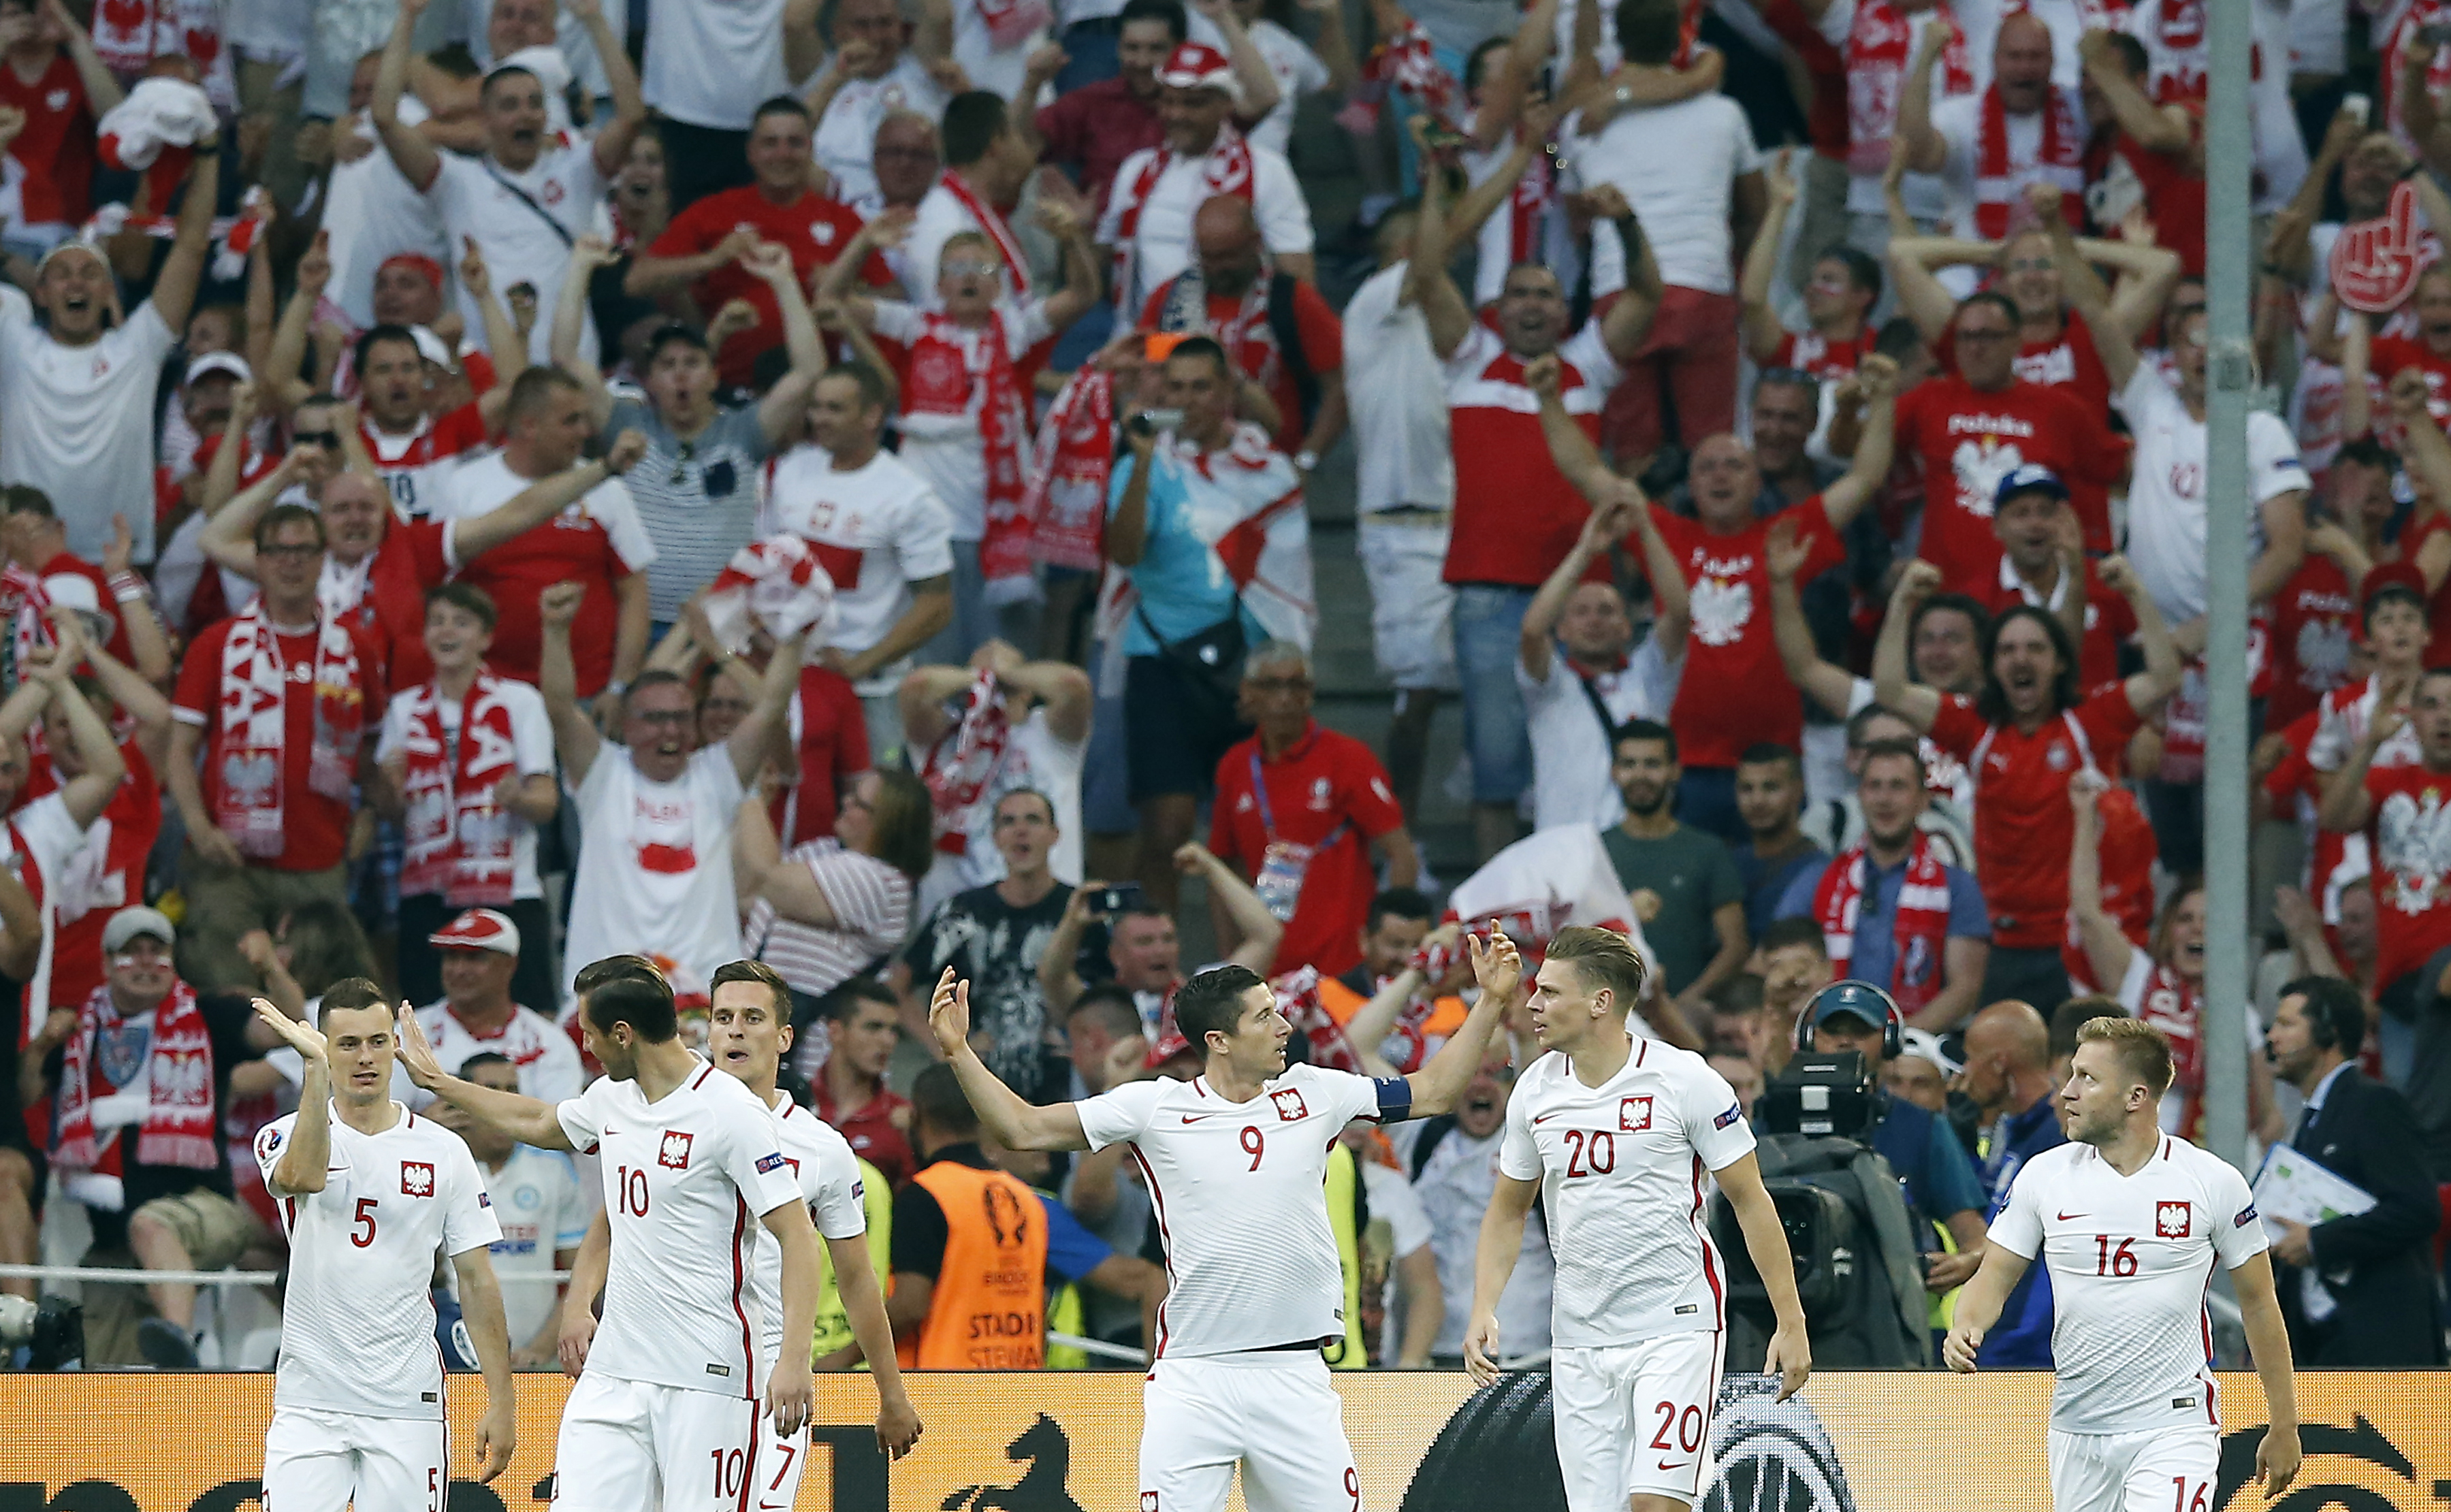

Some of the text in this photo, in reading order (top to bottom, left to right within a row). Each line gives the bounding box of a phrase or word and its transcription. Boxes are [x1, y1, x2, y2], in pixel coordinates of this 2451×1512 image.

[1240, 1125, 1264, 1172] 9
[1564, 1129, 1615, 1178] 20
[618, 1165, 650, 1219] 10
[351, 1197, 379, 1248] 5
[2095, 1234, 2138, 1277] 16
[1649, 1401, 1702, 1453] 20
[428, 1467, 438, 1512] 5
[711, 1448, 743, 1498] 10
[769, 1444, 796, 1491] 7
[2173, 1476, 2207, 1512] 16
